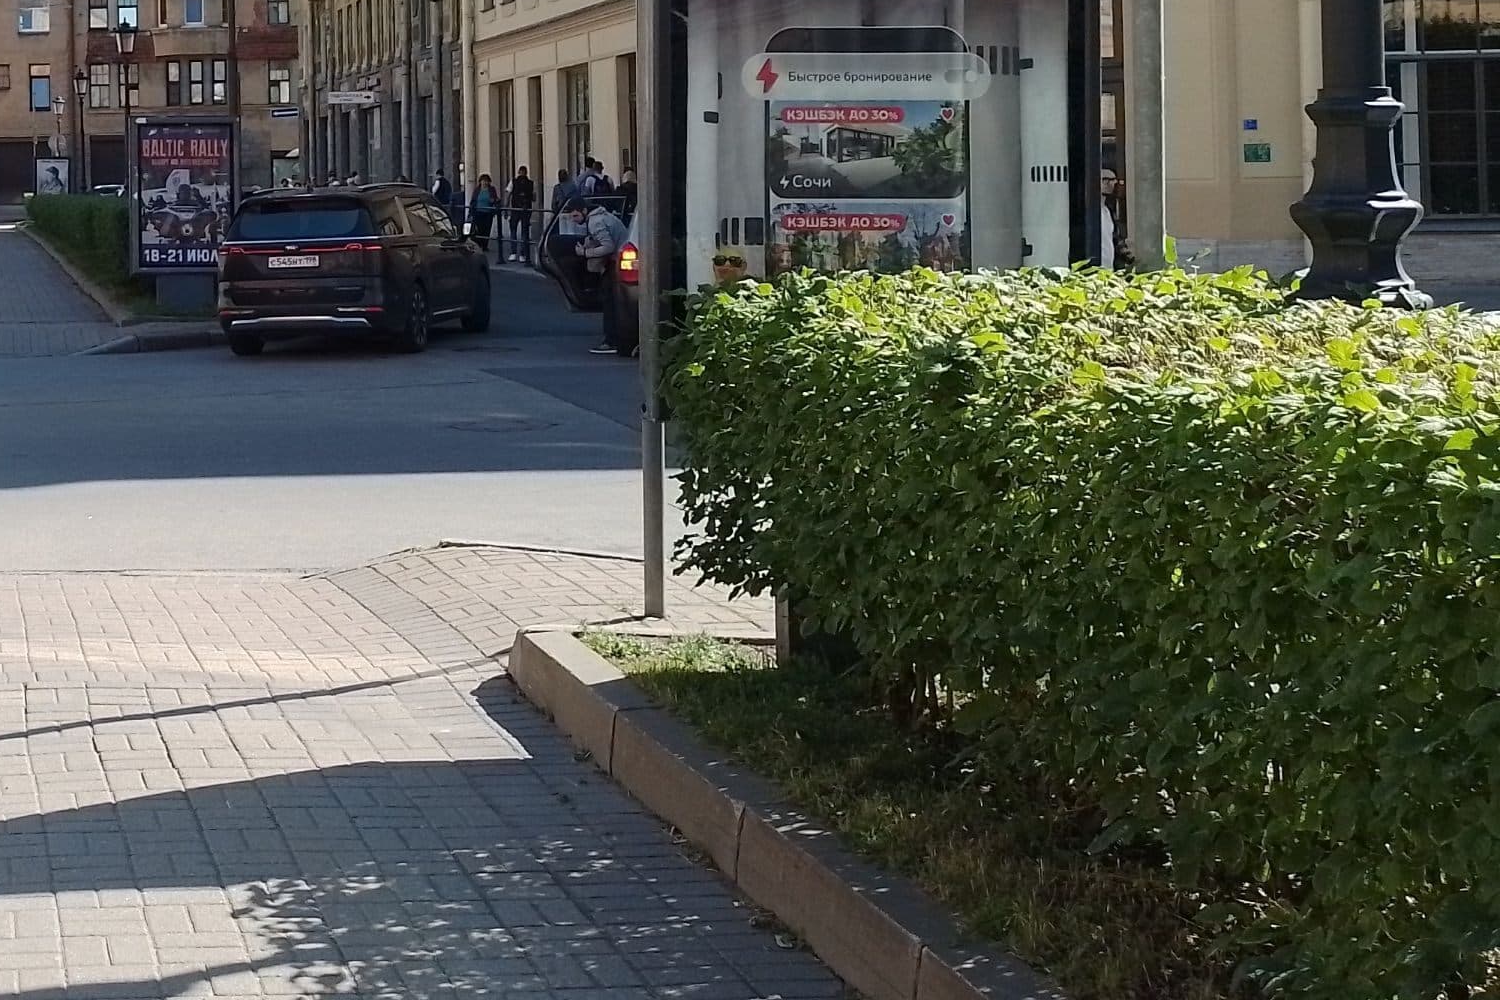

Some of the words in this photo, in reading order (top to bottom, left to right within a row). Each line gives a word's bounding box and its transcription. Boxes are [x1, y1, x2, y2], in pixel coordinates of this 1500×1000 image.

[788, 71, 841, 83] Быстрое
[843, 71, 933, 83] бронирование
[787, 109, 846, 121] КЭШБЭК
[849, 109, 868, 121] ДО
[870, 109, 899, 121] 30%
[142, 139, 185, 157] BALTIC
[190, 138, 228, 157] RALLY
[792, 174, 832, 188] Сочи
[787, 216, 847, 228] КЭШБЭК
[850, 216, 869, 228] ДО
[872, 216, 900, 228] 30%
[143, 249, 183, 262] 18-21
[187, 249, 219, 262] ИЮЛ
